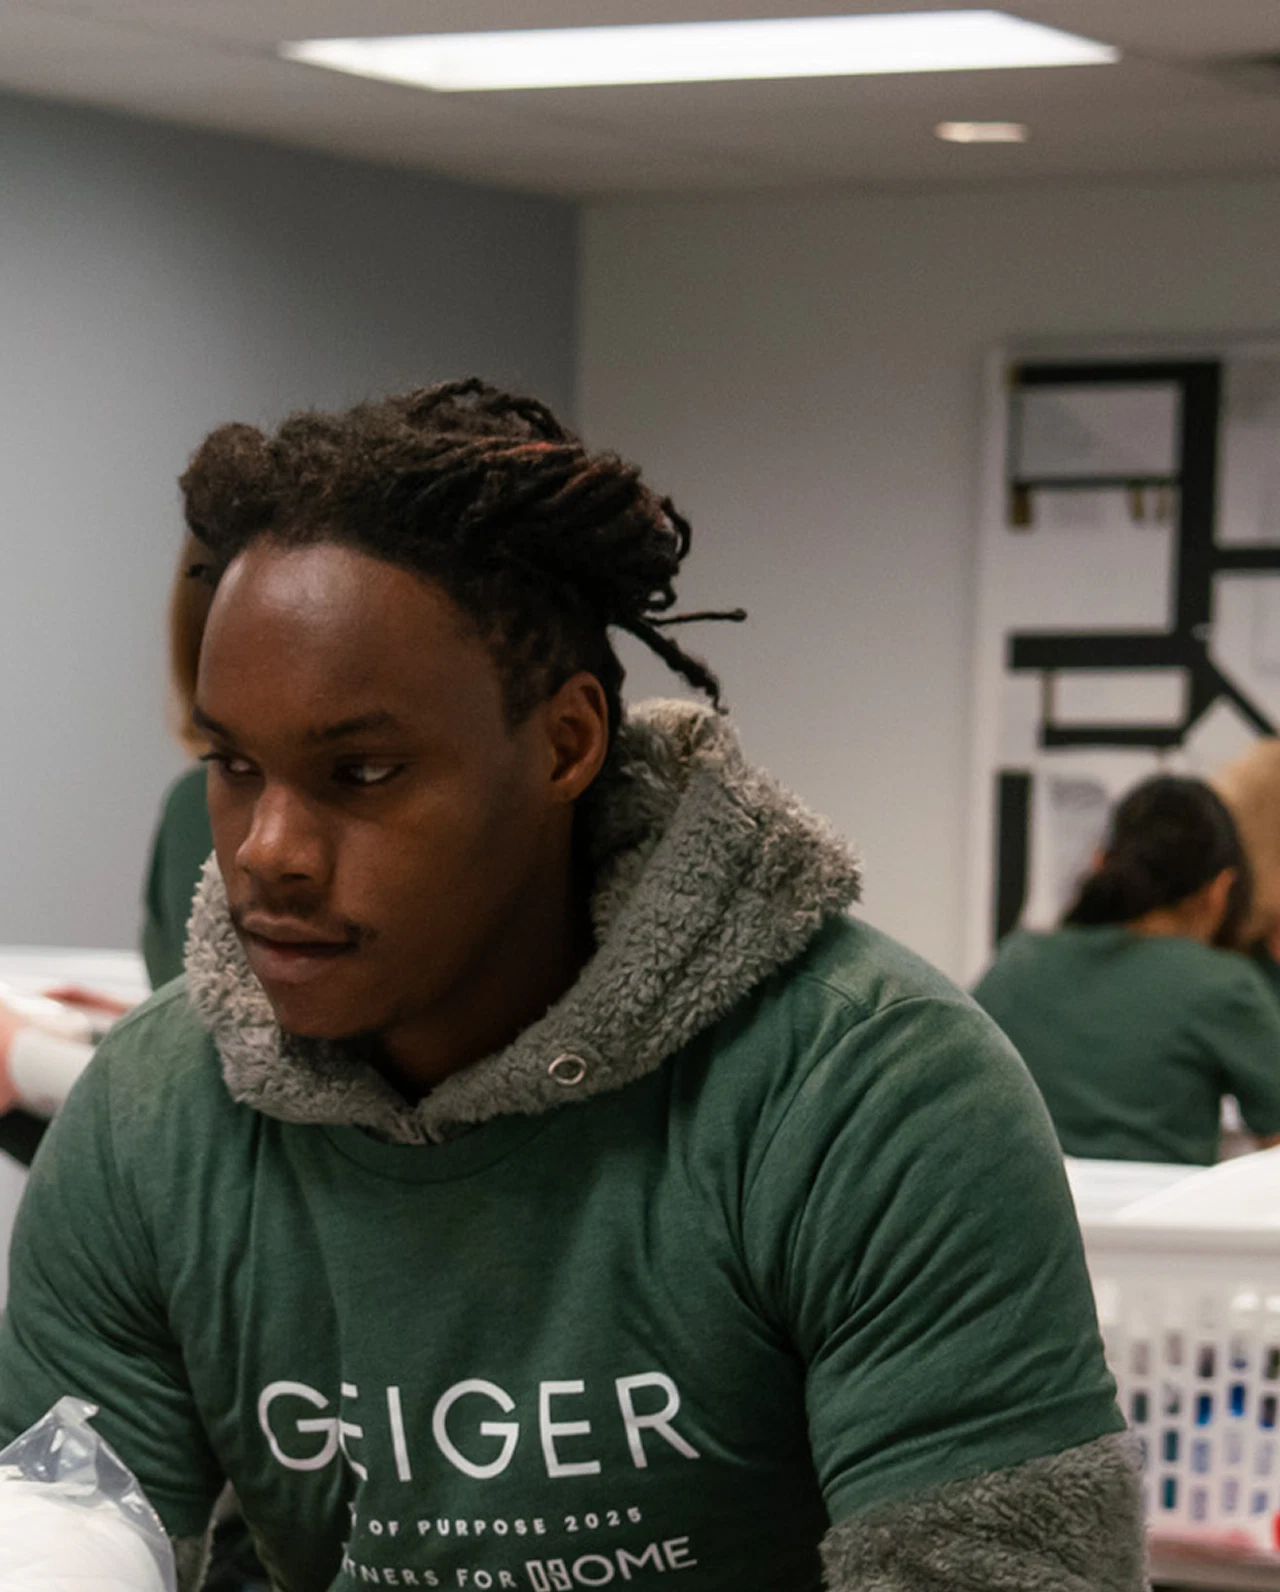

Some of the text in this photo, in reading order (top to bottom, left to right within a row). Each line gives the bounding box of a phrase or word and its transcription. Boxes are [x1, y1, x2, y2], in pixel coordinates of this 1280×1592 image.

[258, 1371, 700, 1482] GEIGER
[369, 1507, 642, 1537] OF PURPOSE 2025
[456, 1568, 517, 1590] FOR
